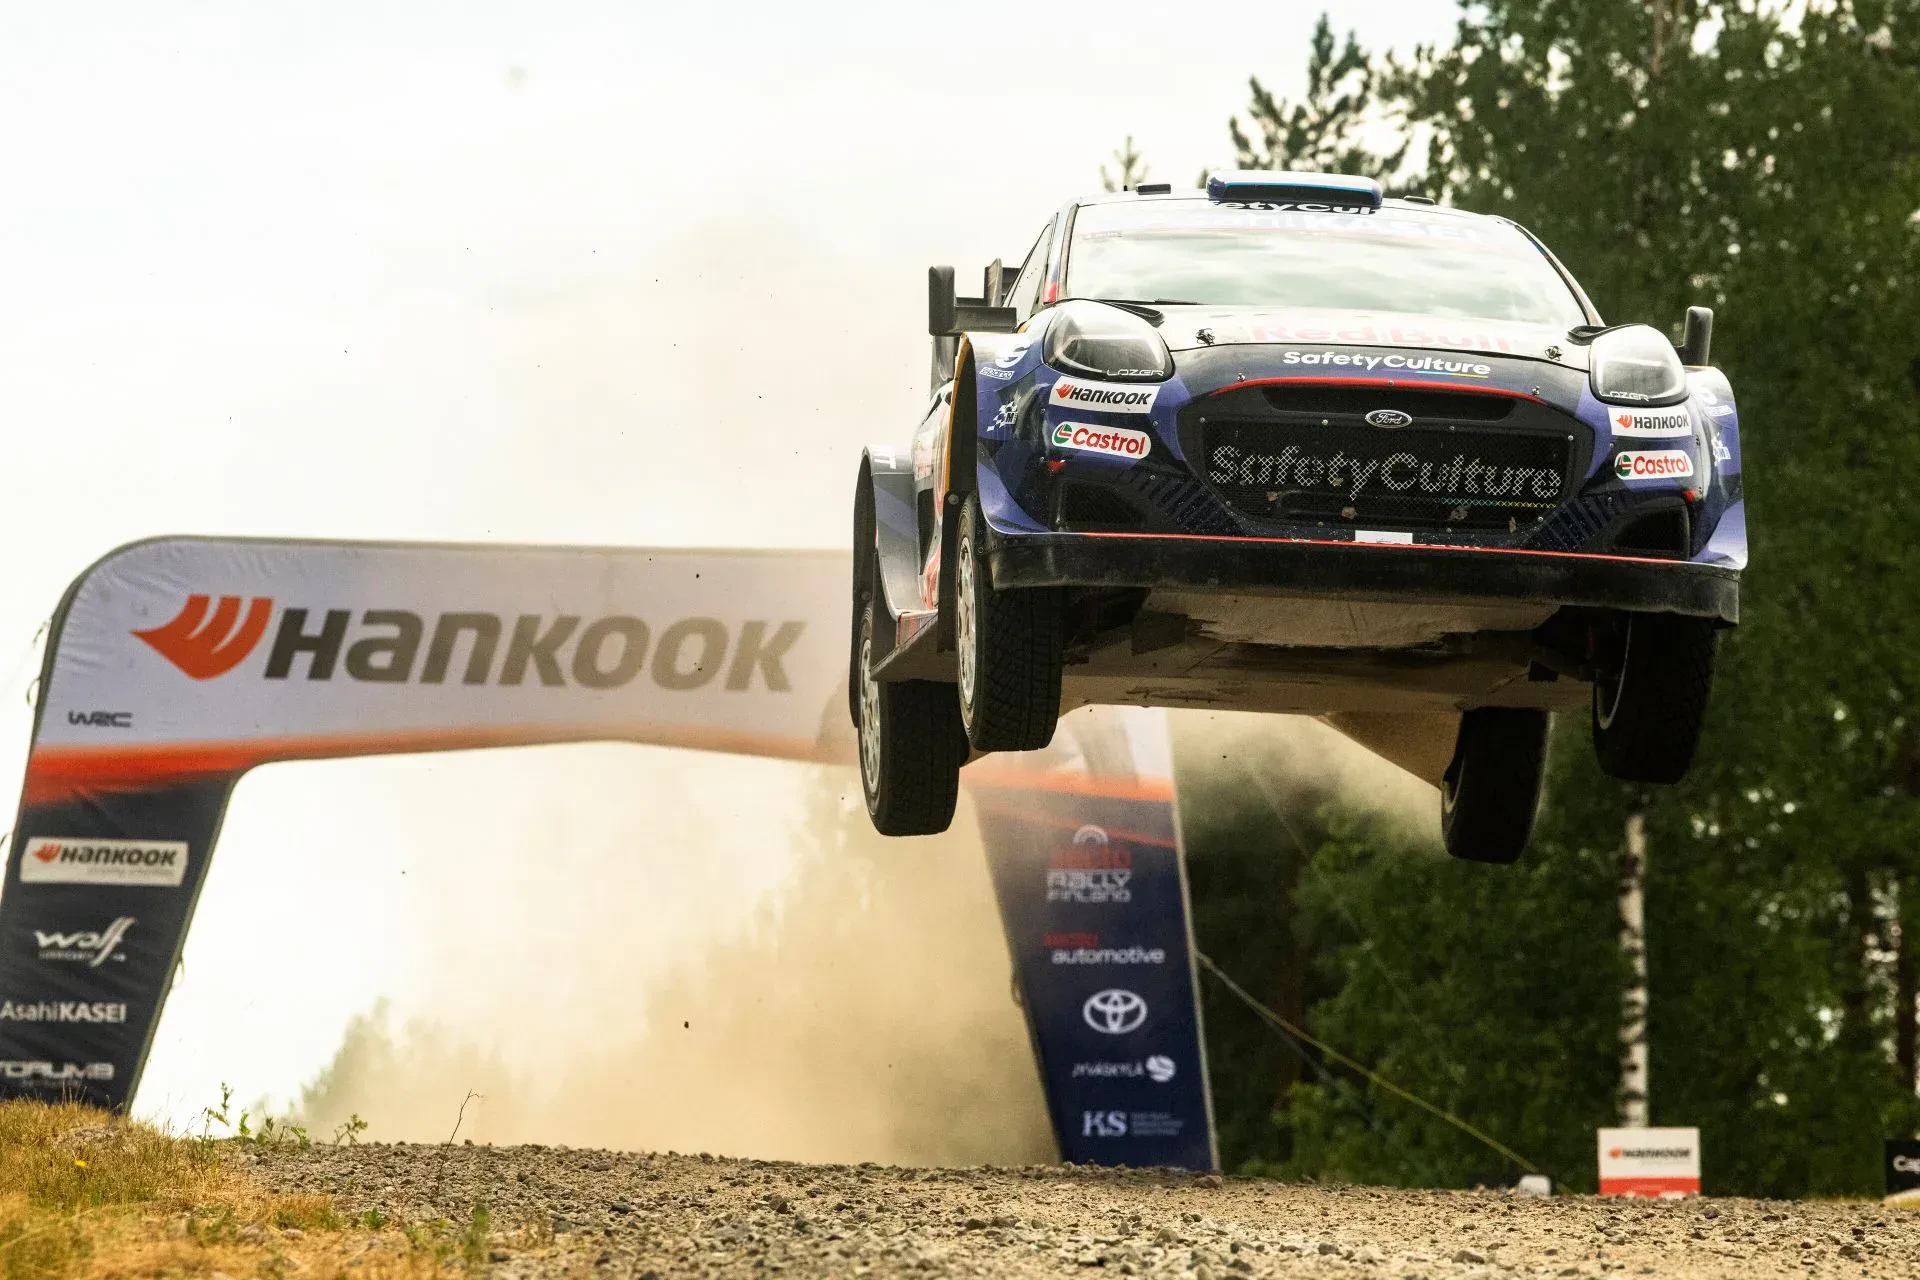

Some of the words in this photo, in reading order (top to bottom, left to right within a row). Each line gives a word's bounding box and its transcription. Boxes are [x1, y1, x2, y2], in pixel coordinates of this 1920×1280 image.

[1283, 351, 1491, 375] SafetyCulture
[1072, 427, 1146, 454] Castrol
[1210, 445, 1562, 501] SafetyCulture
[1633, 454, 1690, 475] Castrol
[68, 710, 133, 728] WRC
[1051, 946, 1166, 965] automotive
[0, 1001, 127, 1022] AsahiKASEI
[1081, 1110, 1129, 1137] KS
